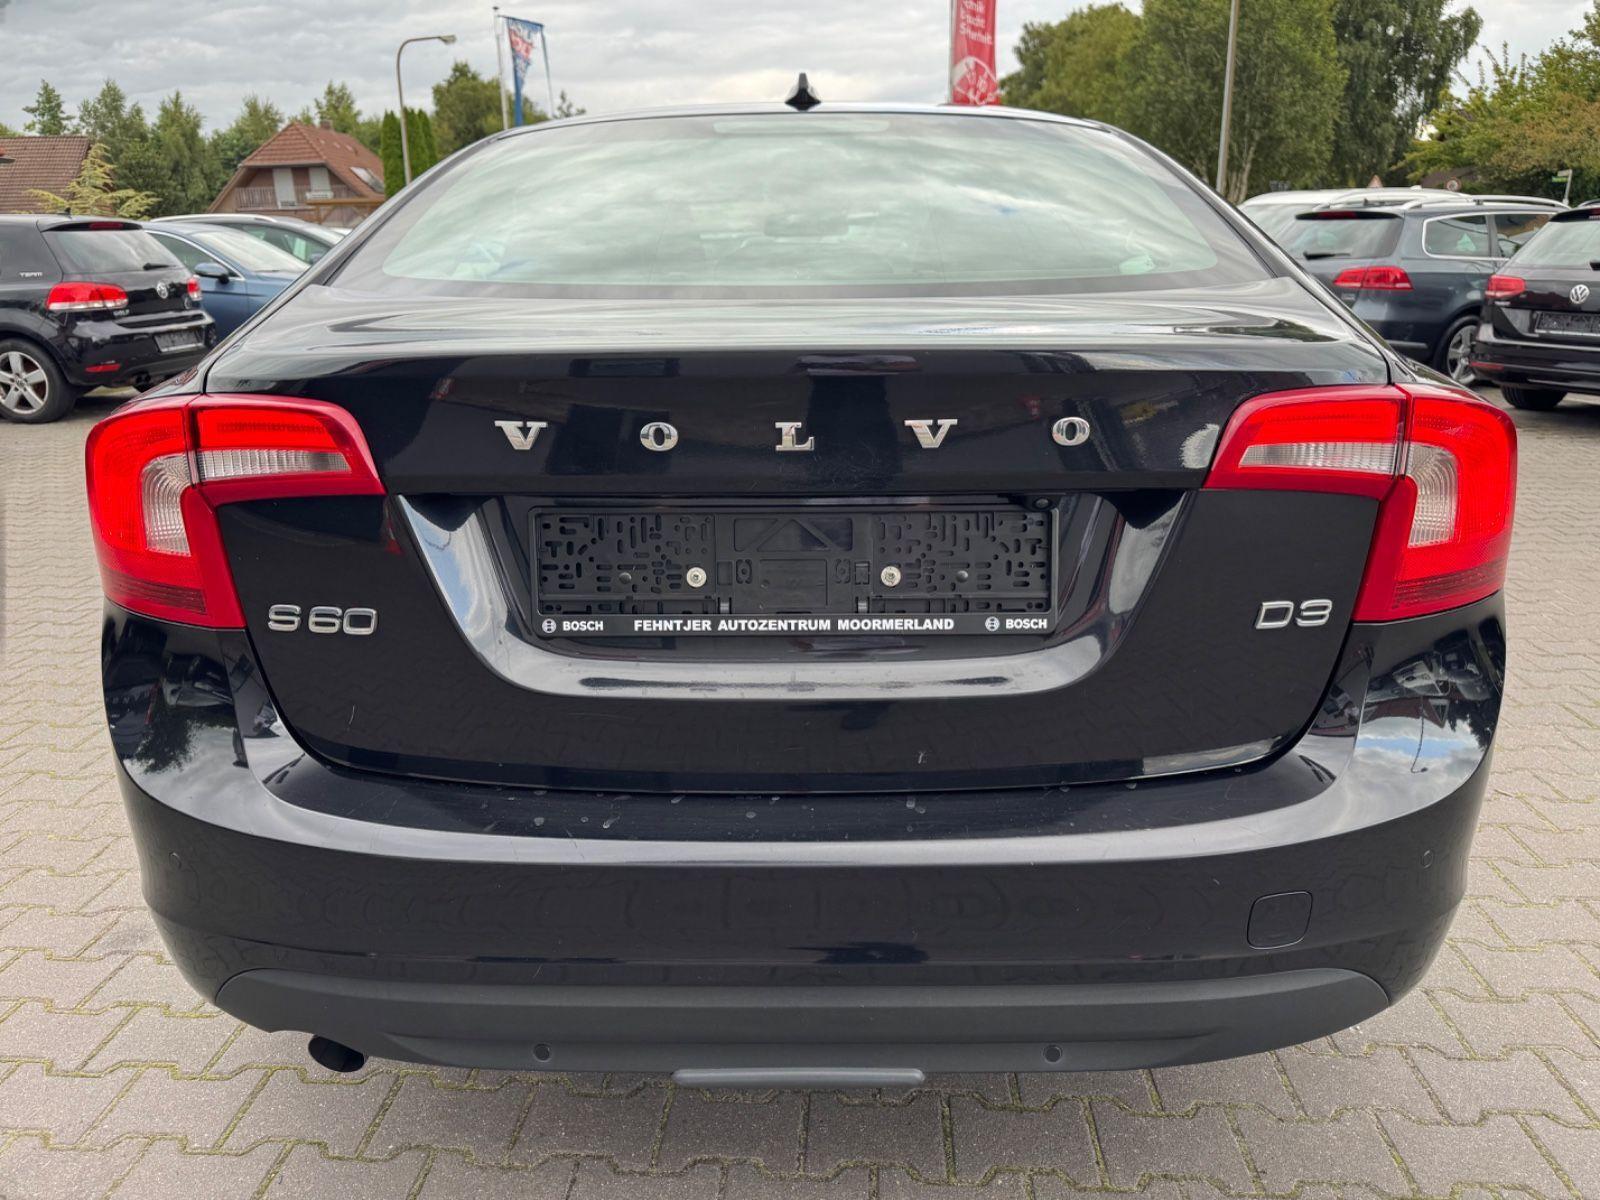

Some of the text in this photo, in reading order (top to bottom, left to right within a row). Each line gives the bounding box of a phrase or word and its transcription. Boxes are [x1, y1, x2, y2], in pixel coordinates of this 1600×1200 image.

[494, 416, 1092, 452] VOLVO
[268, 604, 377, 635] S60
[633, 618, 955, 632] FEHNTJER AUTOZENTRUM MOORMERLAND
[1004, 618, 1048, 630] BOSCH
[1255, 599, 1332, 629] D3
[562, 620, 604, 631] BOSCH
